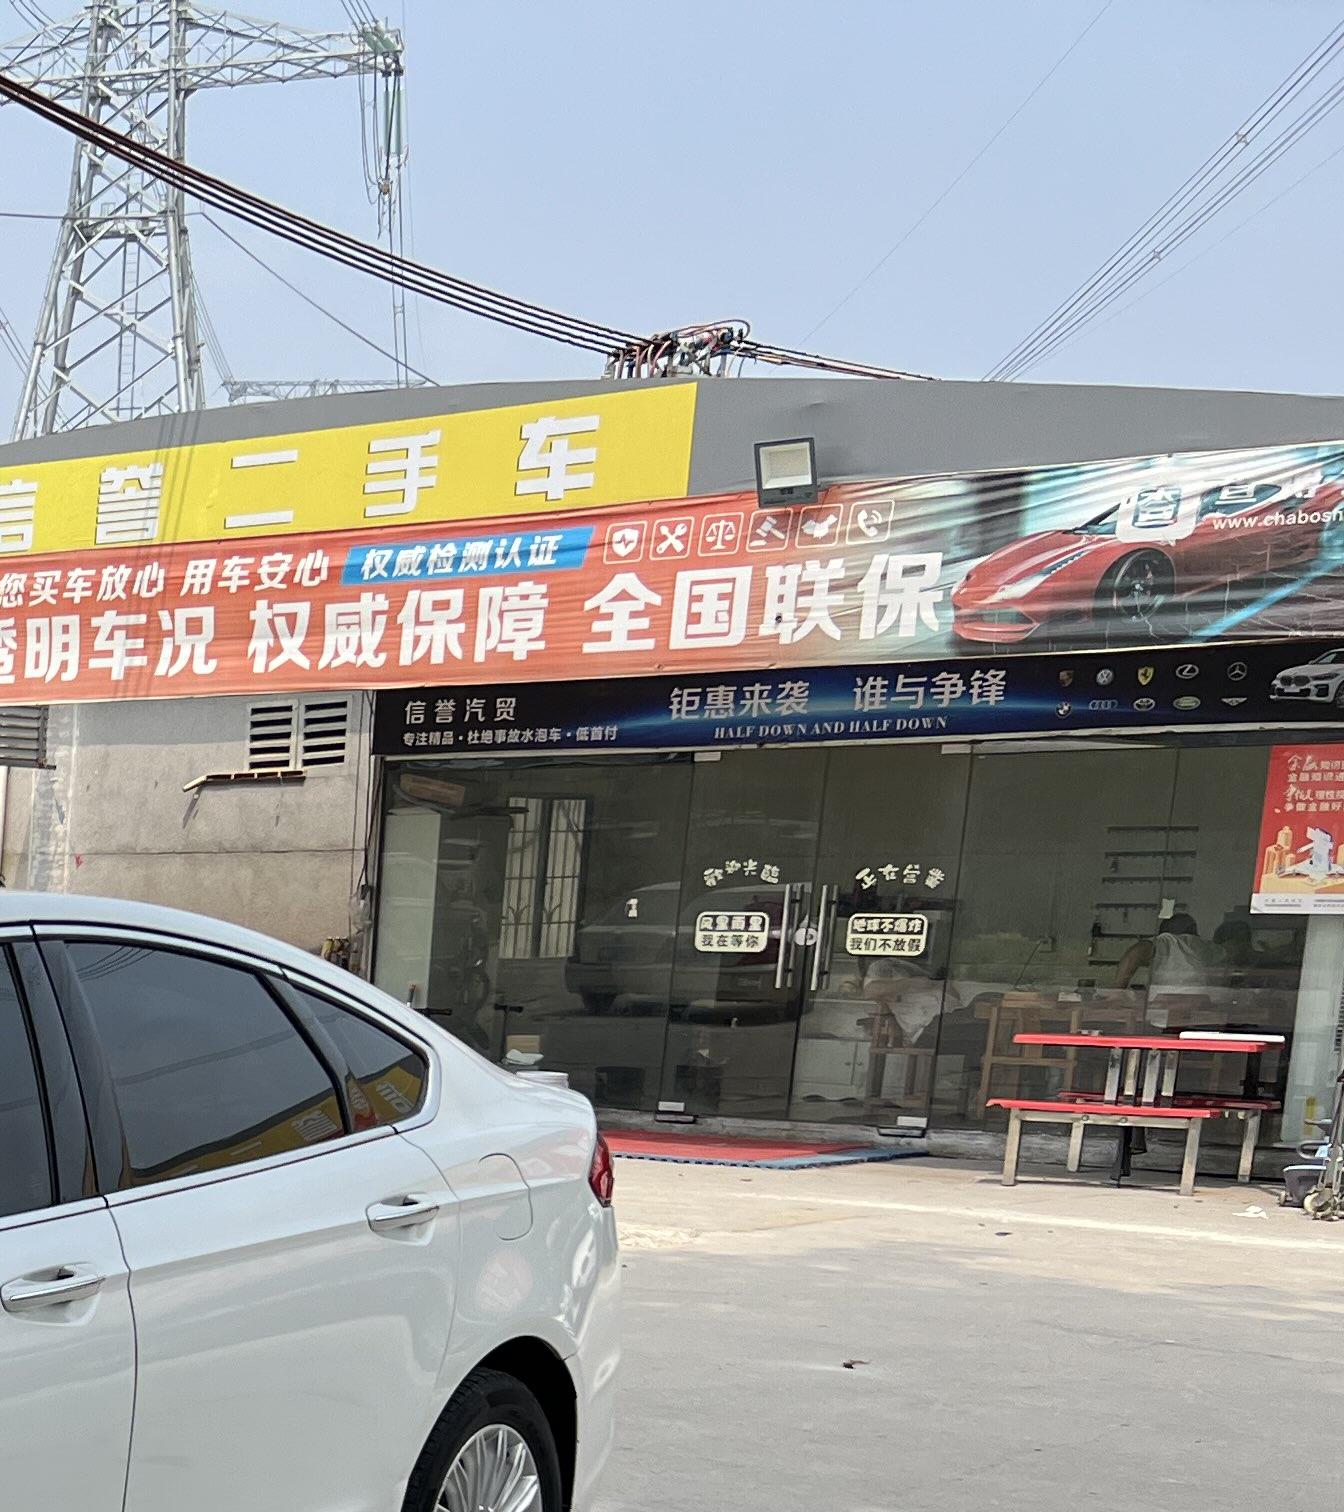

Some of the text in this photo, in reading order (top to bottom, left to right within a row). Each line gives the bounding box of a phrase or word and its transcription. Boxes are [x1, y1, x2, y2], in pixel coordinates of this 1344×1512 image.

[179, 549, 330, 597] 用车安心
[360, 534, 564, 580] 权威检测认证
[247, 580, 550, 675] 权威保障
[581, 551, 945, 654] 全国联保
[404, 697, 517, 725] 信誉汽贸
[668, 668, 1008, 721] 钜惠来袭 谁与争锋
[714, 715, 949, 740] HALF DOWN AND HALF DOWN
[700, 933, 760, 948] 我在等你
[850, 936, 921, 952] 我们不放假
